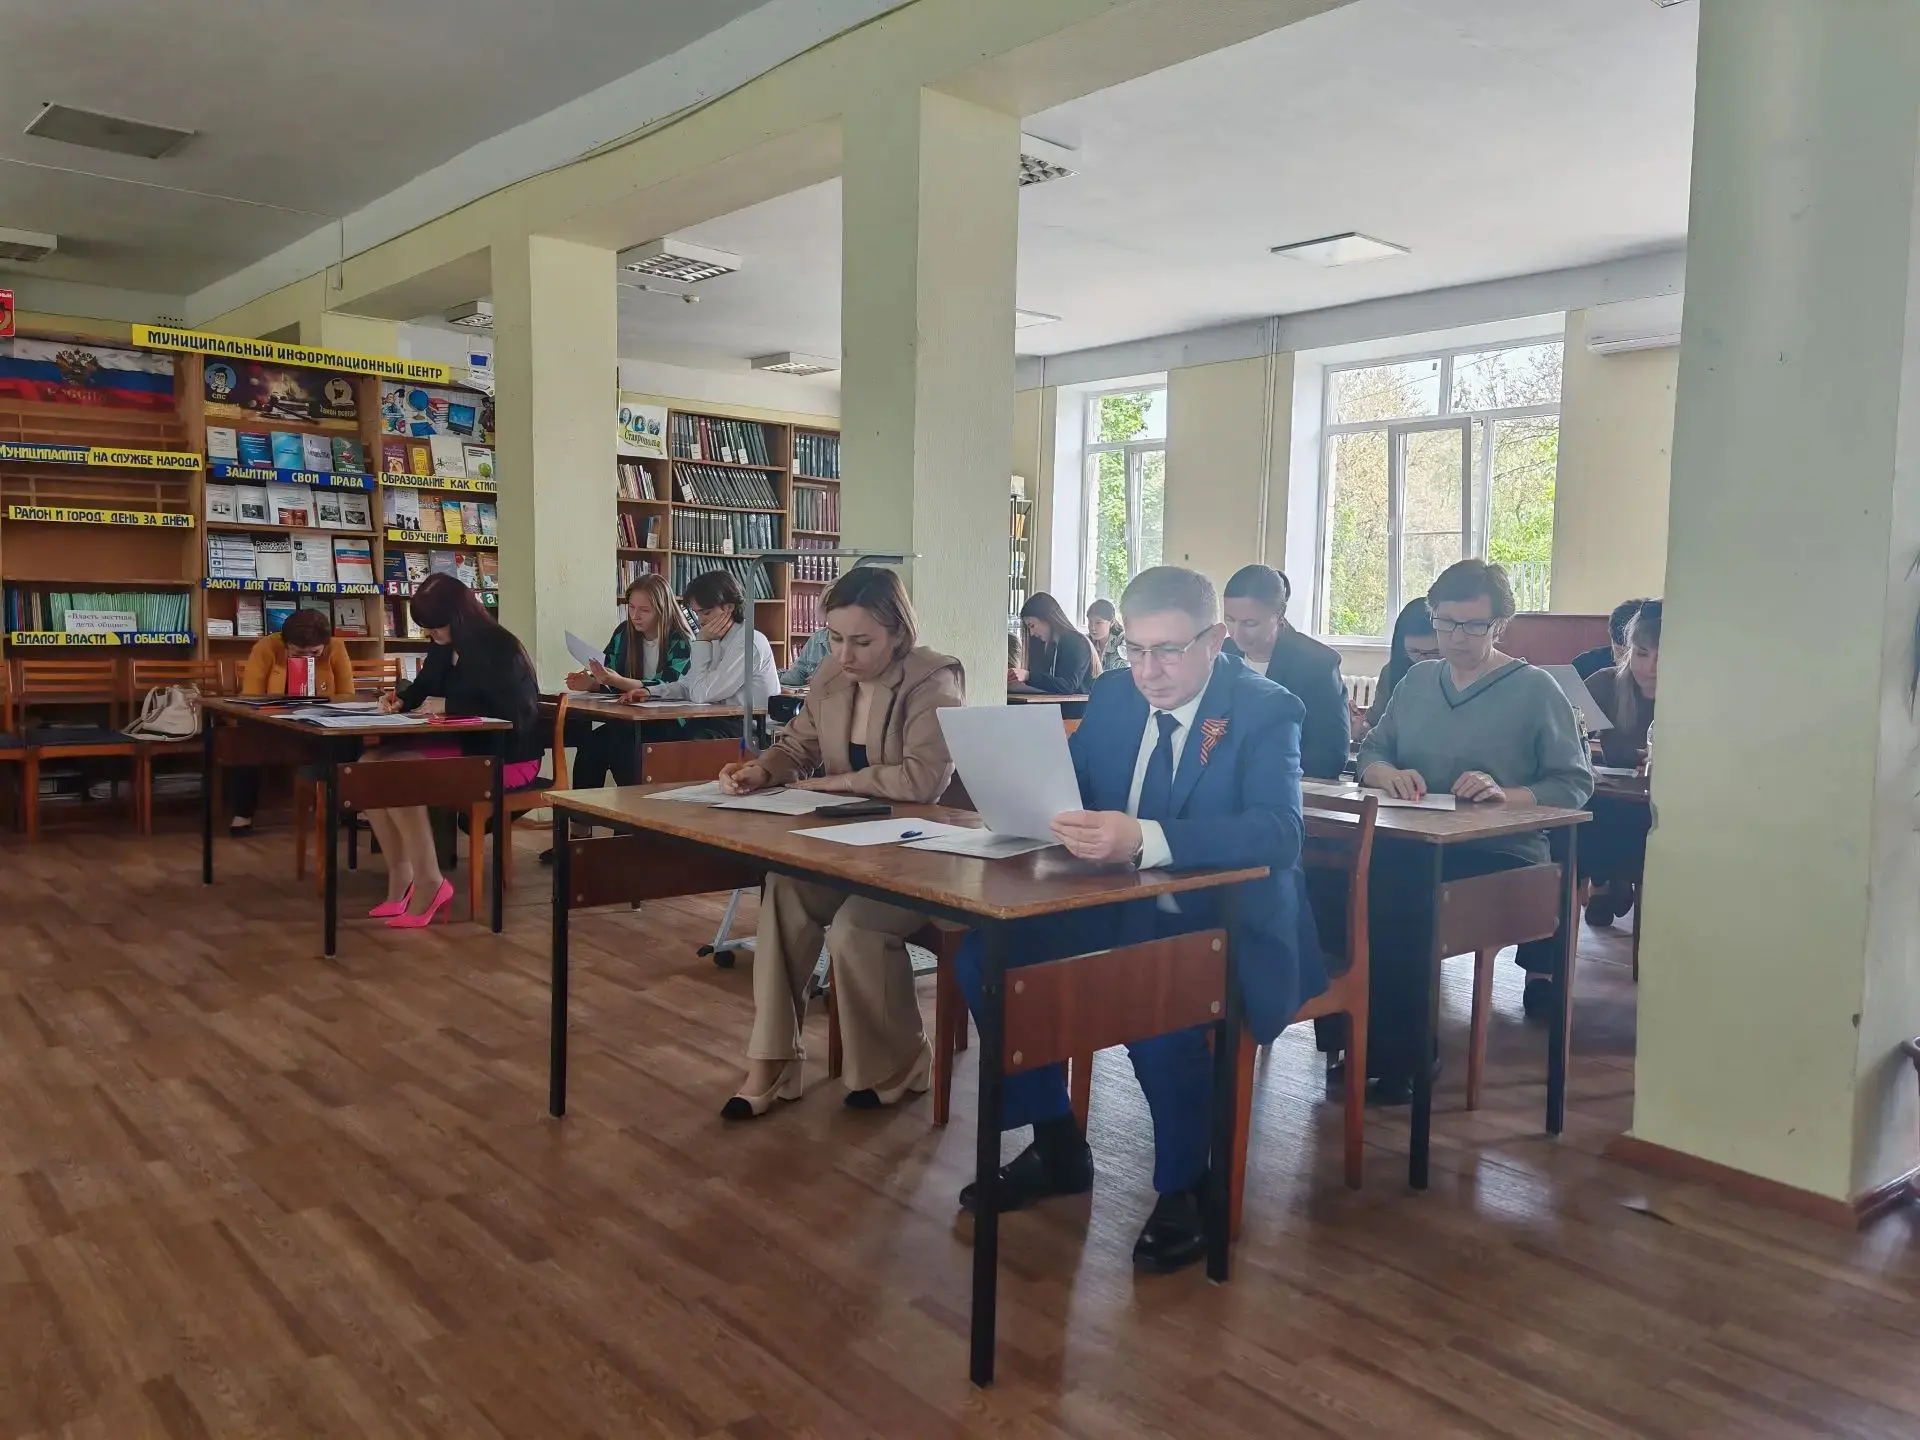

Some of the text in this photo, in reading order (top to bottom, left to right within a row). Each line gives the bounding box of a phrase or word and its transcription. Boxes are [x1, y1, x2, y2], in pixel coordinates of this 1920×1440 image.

[147, 330, 443, 380] МУНИЦИПАЛЬНЫЙ ИНФОРМАЦИОННЫЙ ЦЕНТР
[93, 451, 107, 463] НА
[111, 453, 153, 466] СЛУЖБЕ
[157, 456, 200, 468] НАРОДА
[225, 466, 364, 488] ЗАЩИТИМ СВОИ ПРАВА
[381, 472, 445, 488] ОБРАЗОВАНИЕ
[450, 479, 470, 490] КАК
[14, 506, 51, 519] РАЙОН
[56, 510, 63, 520] И
[111, 513, 139, 524] ДЕНЬ
[144, 514, 157, 525] ЗА
[400, 530, 449, 543] ОБУЧЕНИЕ
[206, 578, 241, 590] ЗАКОН
[244, 580, 264, 590] ДЛЯ
[297, 583, 311, 592] ТЫ
[316, 583, 337, 593] ДЛЯ
[341, 584, 380, 595] ЗАКОНА
[16, 632, 191, 645] ДИАЛОГ ВЛАСТИ И ОБЩЕСТВА
